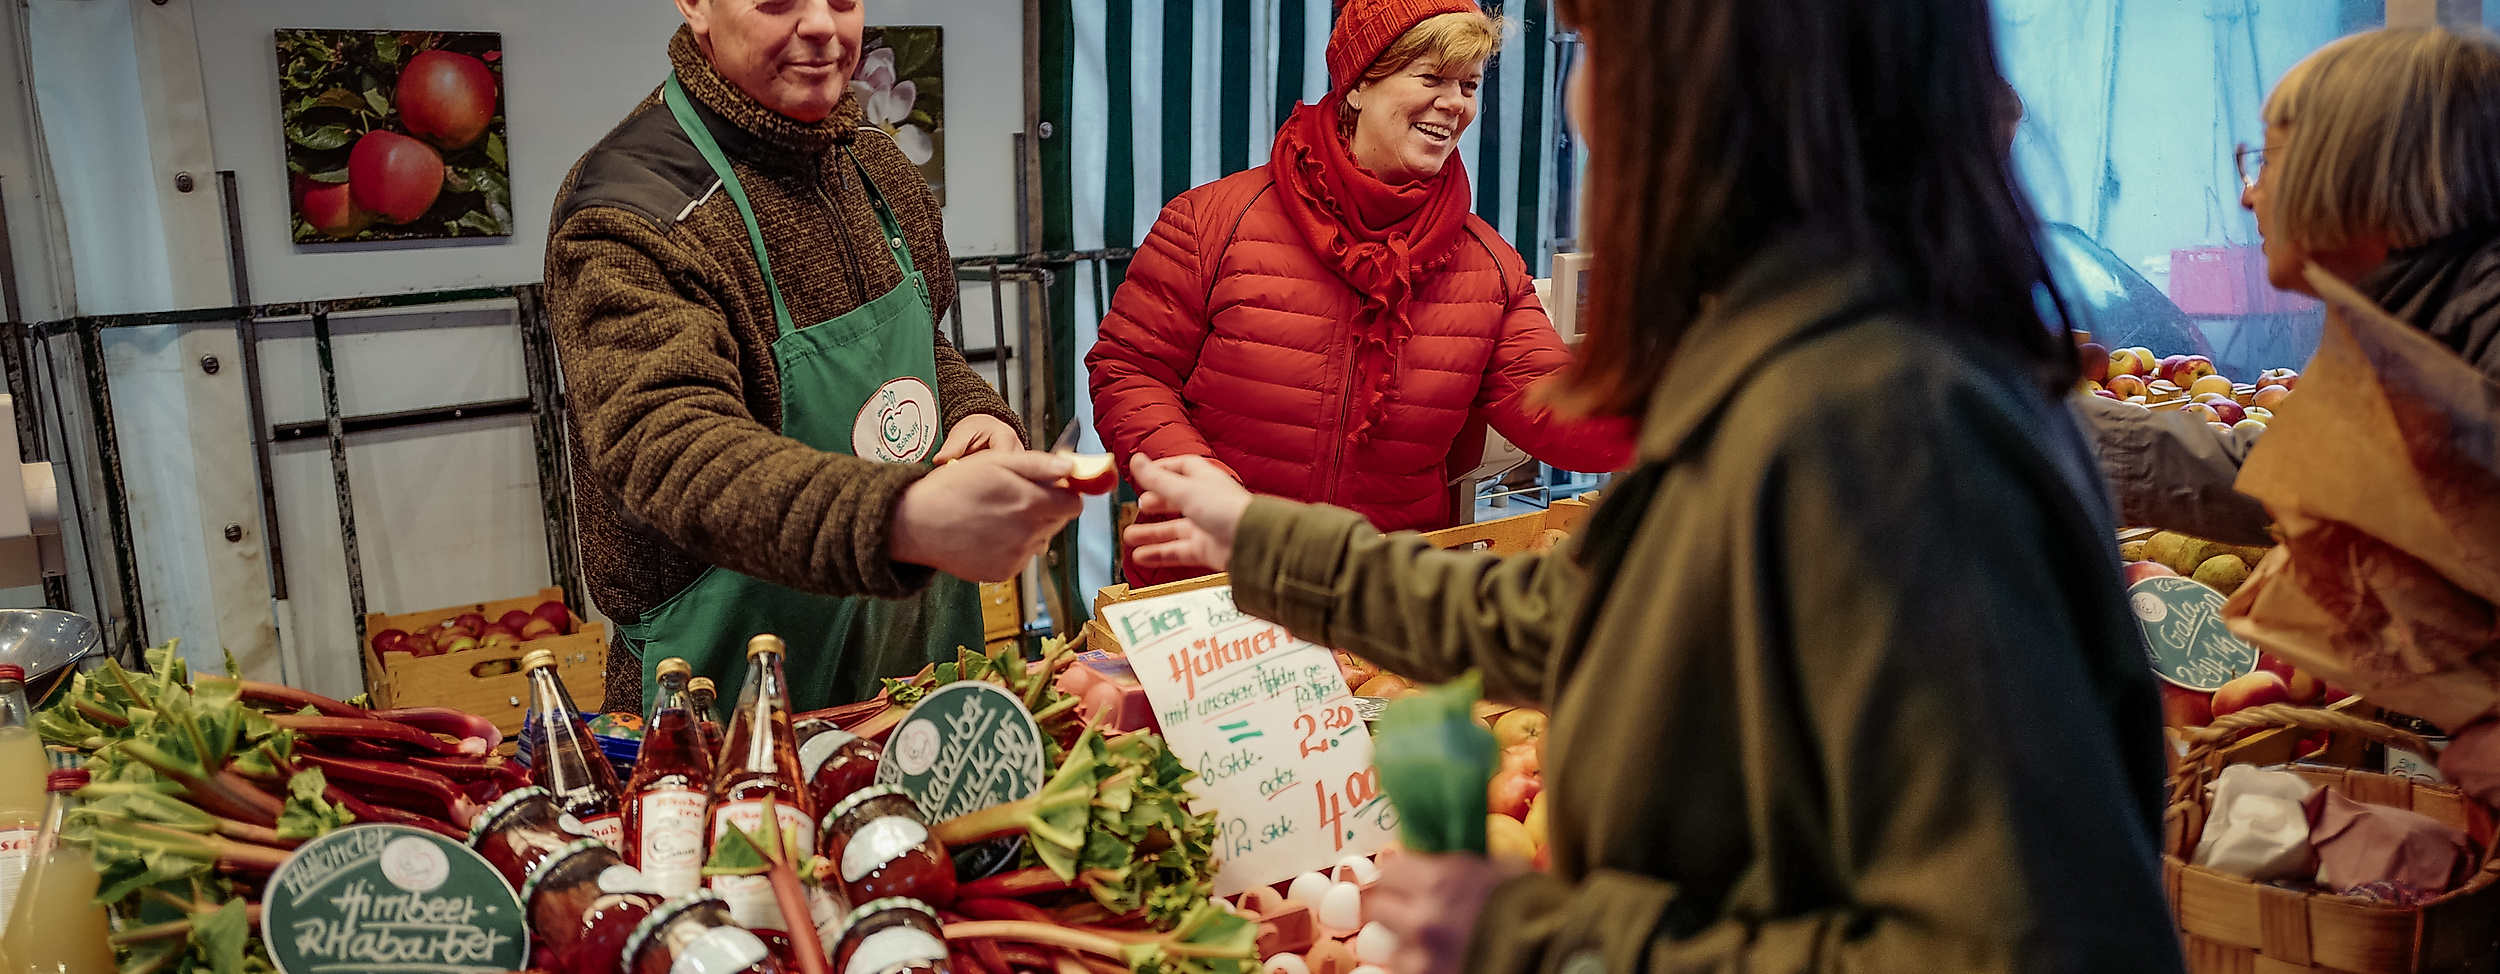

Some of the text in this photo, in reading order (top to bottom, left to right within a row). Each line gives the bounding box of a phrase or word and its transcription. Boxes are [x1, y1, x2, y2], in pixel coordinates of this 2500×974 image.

[1121, 608, 1191, 646] Eier
[2160, 601, 2200, 649] Gala
[1163, 700, 1190, 727] mit
[1199, 752, 1215, 787] 6
[1259, 768, 1295, 796] oder
[1220, 818, 1253, 862] 12
